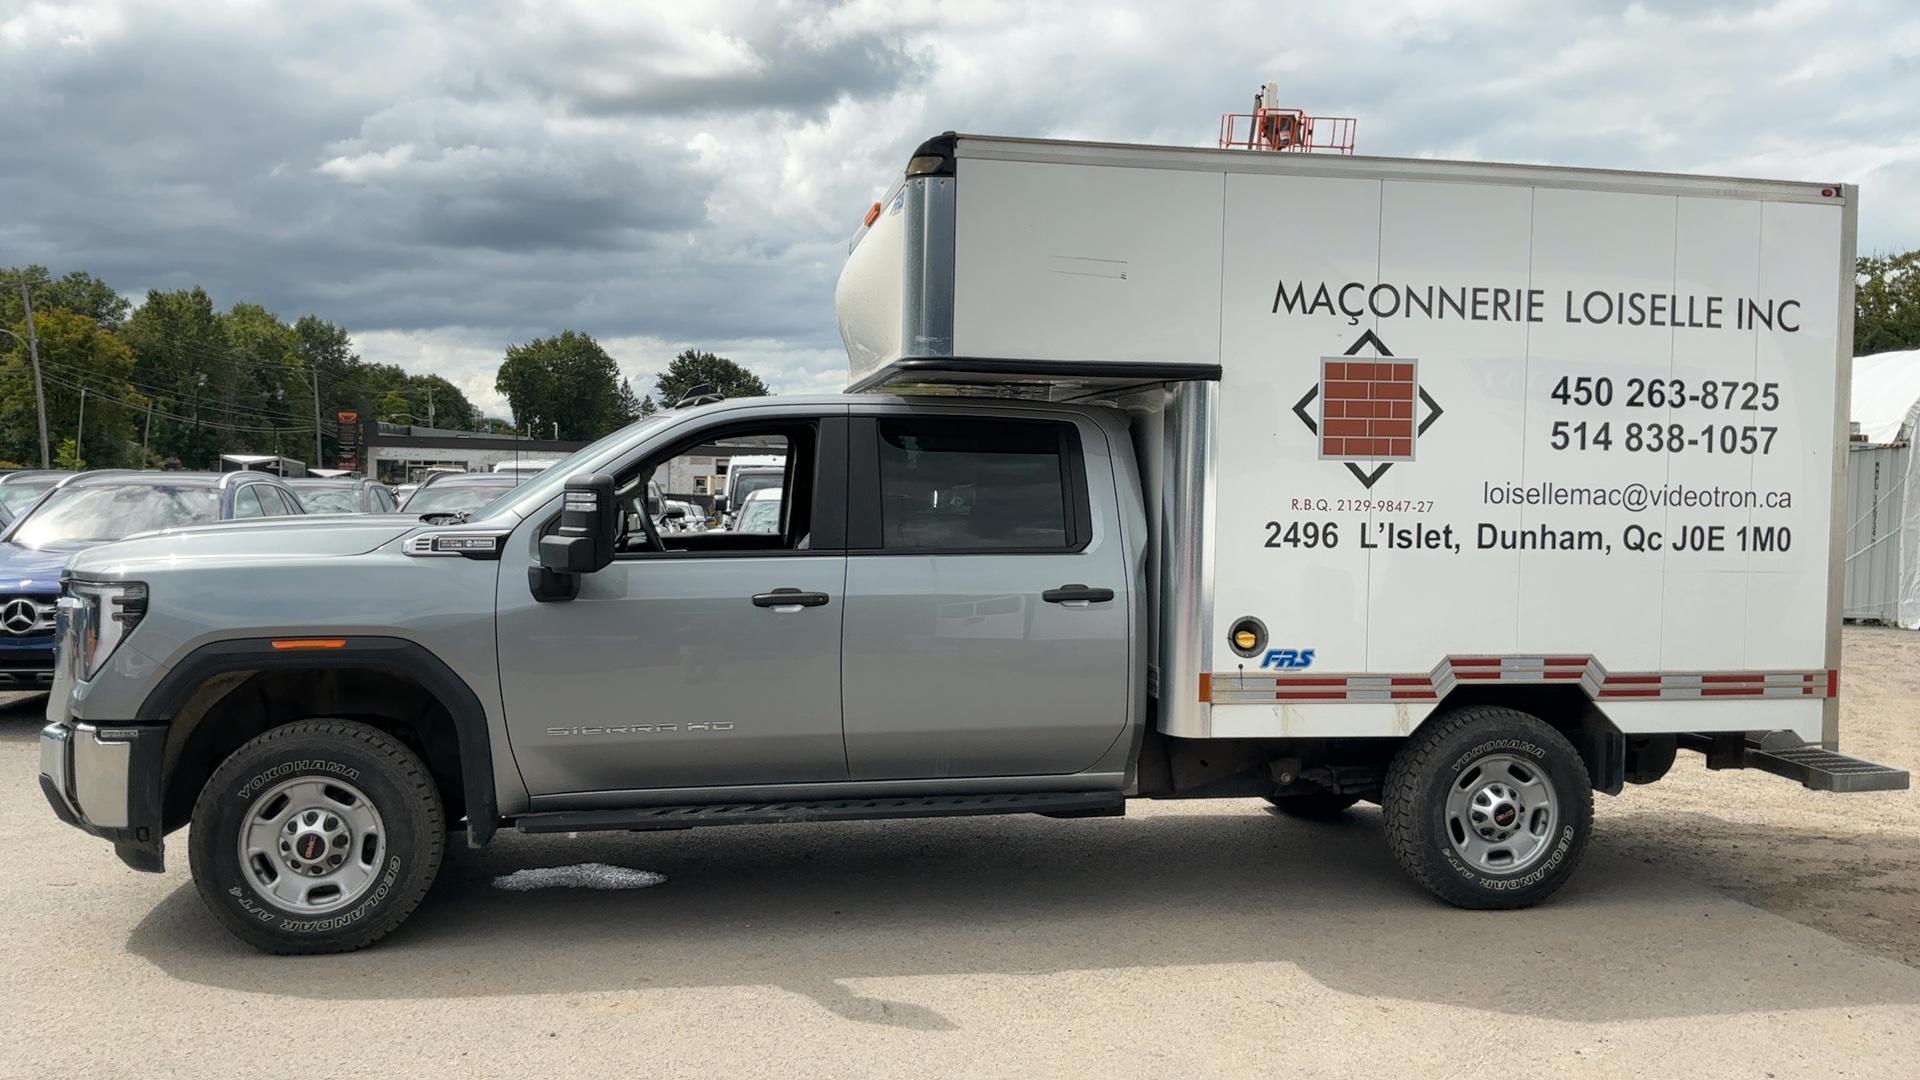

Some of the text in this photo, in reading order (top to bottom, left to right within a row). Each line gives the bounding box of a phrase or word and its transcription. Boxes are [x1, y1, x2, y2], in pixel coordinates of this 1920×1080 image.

[1272, 279, 1801, 333] MAÇONNERIE LOISELLE INC
[1550, 376, 1780, 412] 450 263-8725
[1550, 421, 1778, 455] 514 838-1057
[1292, 499, 1434, 513] R.B.Q. 2129-9847-27
[1483, 481, 1792, 512] loisellemac@videotron.ca
[1264, 521, 1792, 556] 2496 L'Islet, Dunham, Qc J0E 1M0
[1260, 648, 1316, 669] FRS
[547, 721, 734, 736] SIERRA HD
[1452, 739, 1546, 772] YOKOHAMA
[238, 760, 360, 800] YOKOHAMA
[305, 835, 317, 858] GMC
[1479, 825, 1574, 890] GEOLANDAR
[280, 855, 401, 932] GEOLANDAR
